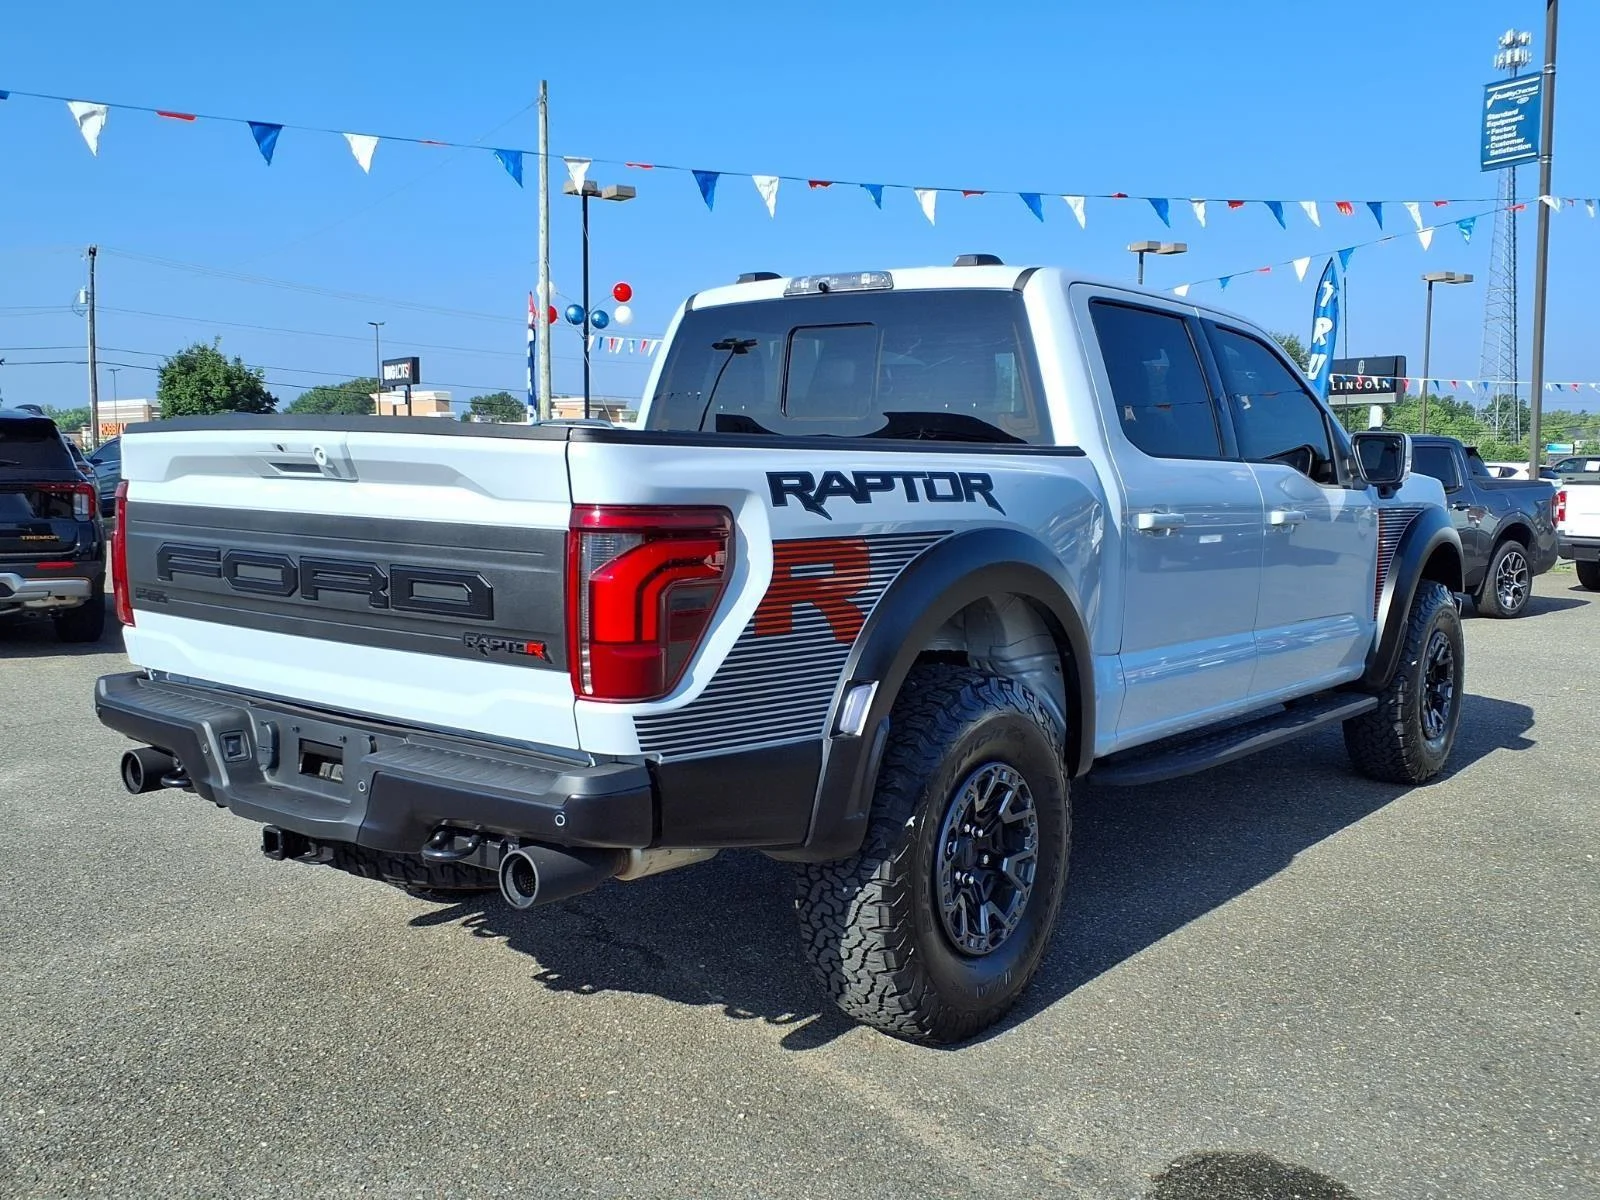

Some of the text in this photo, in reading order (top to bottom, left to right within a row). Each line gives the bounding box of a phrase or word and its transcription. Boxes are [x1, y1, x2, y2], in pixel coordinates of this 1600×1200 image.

[766, 471, 1007, 520] RAPTOR
[156, 541, 495, 621] FORD
[754, 538, 870, 645] R
[464, 632, 553, 664] RAPTOR
